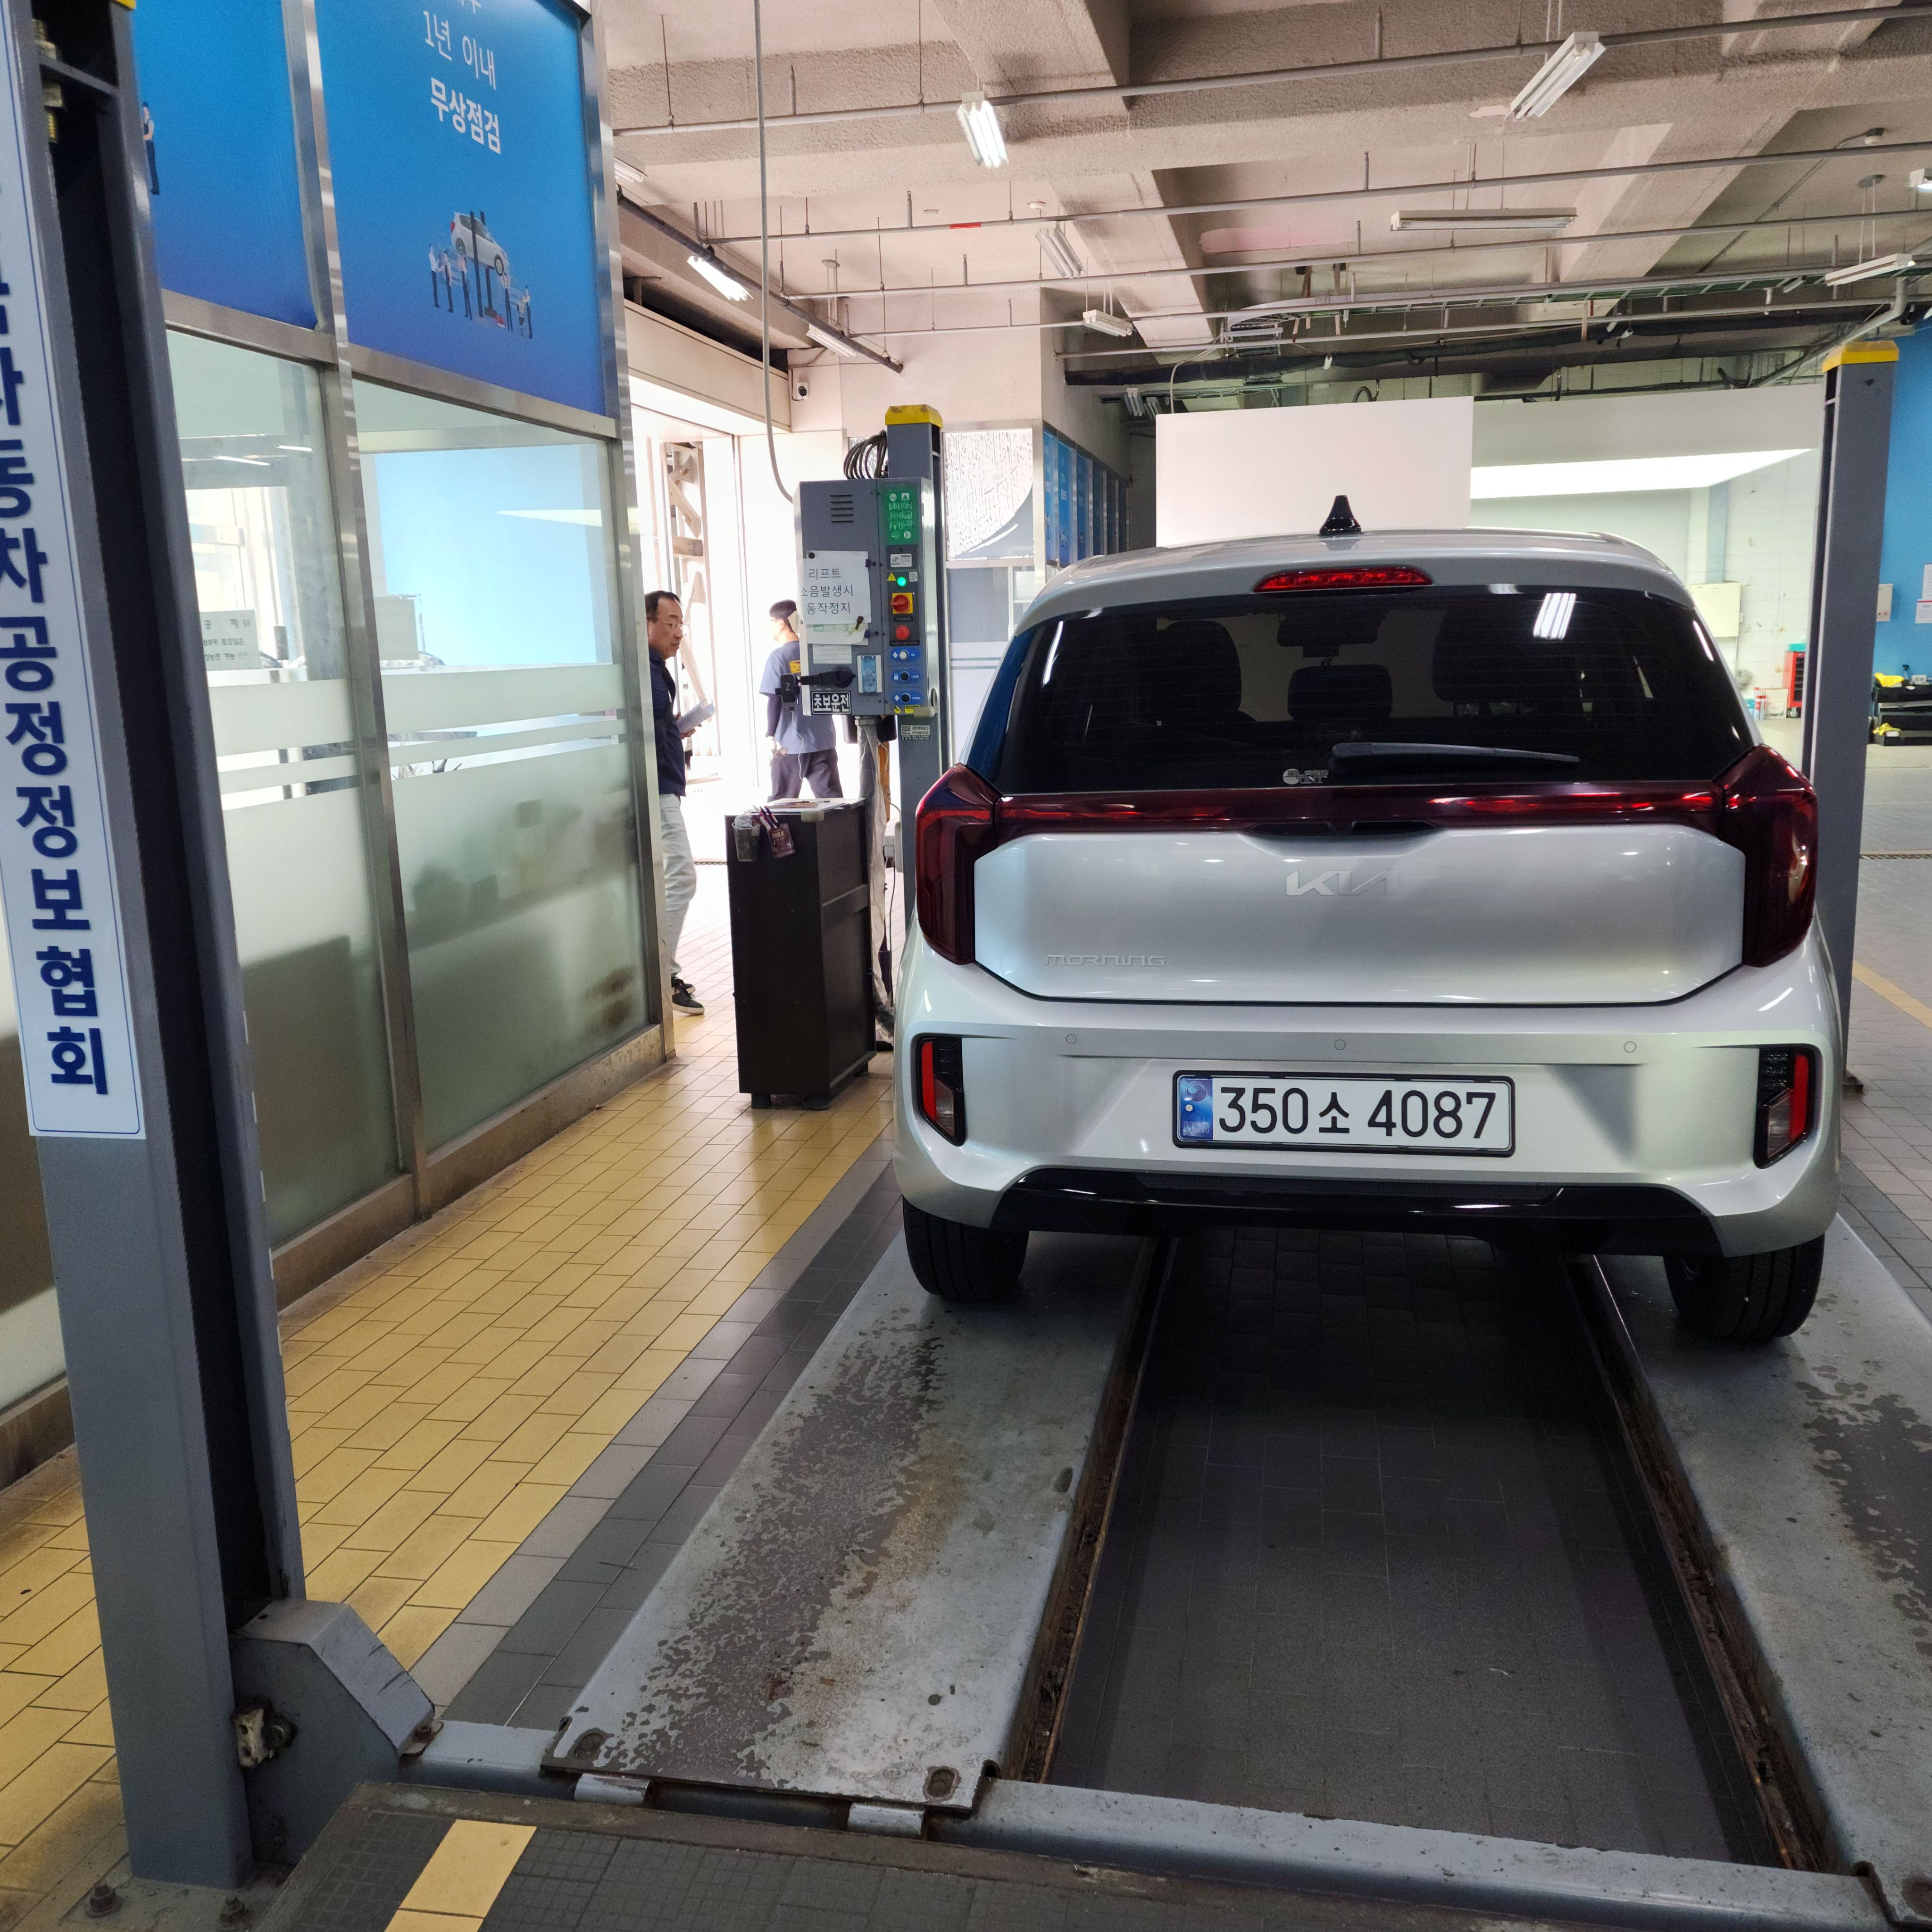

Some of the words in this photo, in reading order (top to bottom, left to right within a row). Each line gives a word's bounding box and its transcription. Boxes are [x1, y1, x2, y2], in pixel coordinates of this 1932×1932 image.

[424, 10, 452, 61] 1년
[462, 35, 496, 90] 이내
[431, 77, 500, 154] 무상점검
[809, 568, 841, 580] 리프트
[800, 584, 853, 597] 소음발생시
[806, 602, 850, 615] 동작정지
[0, 282, 108, 1095] 동차공정정보협회
[814, 693, 849, 712] 초보운전
[1286, 869, 1399, 896] KIA
[1044, 955, 1166, 967] MORNING
[1219, 1087, 1349, 1134] 350소
[1368, 1090, 1496, 1139] 4087
